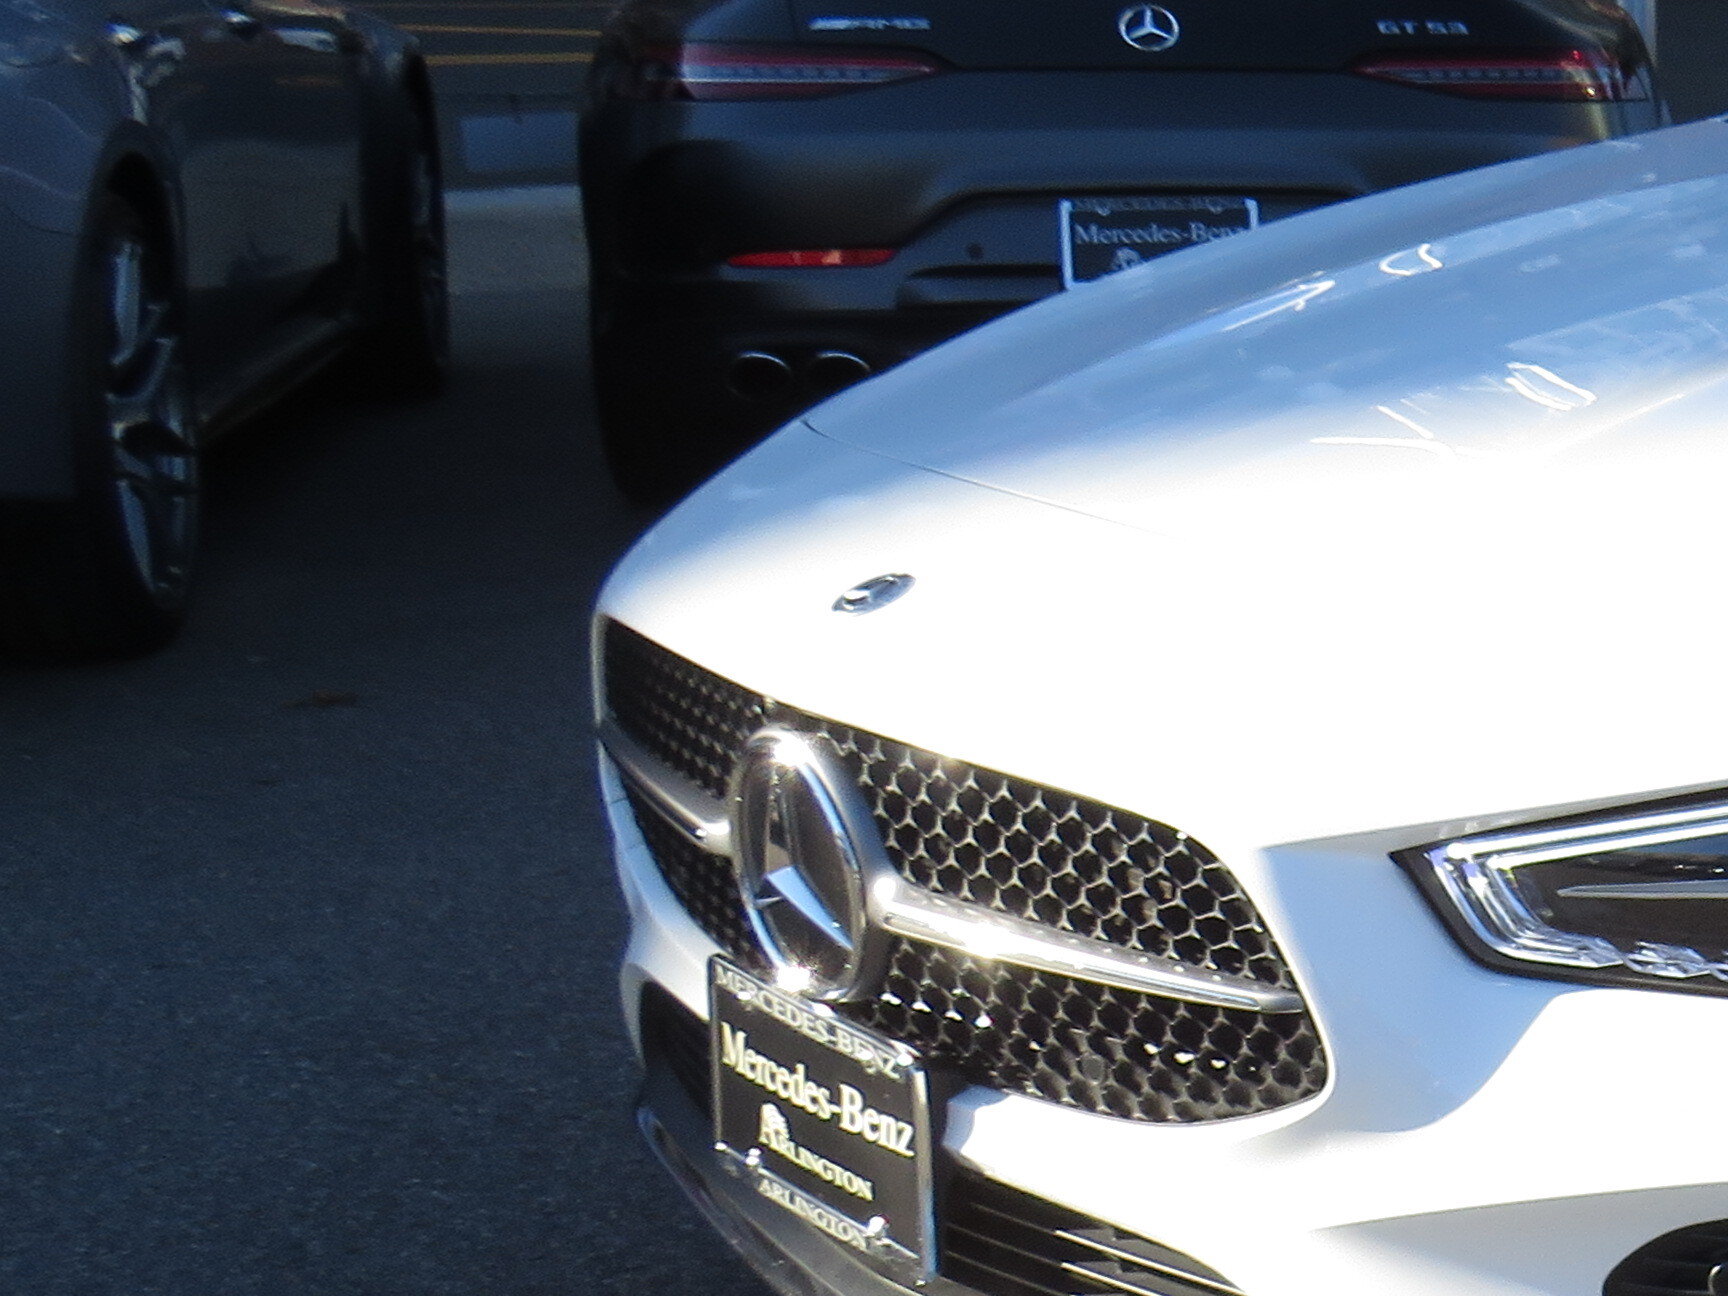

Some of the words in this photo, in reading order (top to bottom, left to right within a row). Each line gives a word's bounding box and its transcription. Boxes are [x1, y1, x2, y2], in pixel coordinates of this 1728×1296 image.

[1074, 222, 1246, 244] Mercedes-Ben
[721, 1021, 915, 1157] Mercedes-Benz
[759, 1122, 874, 1202] ARLINGTON
